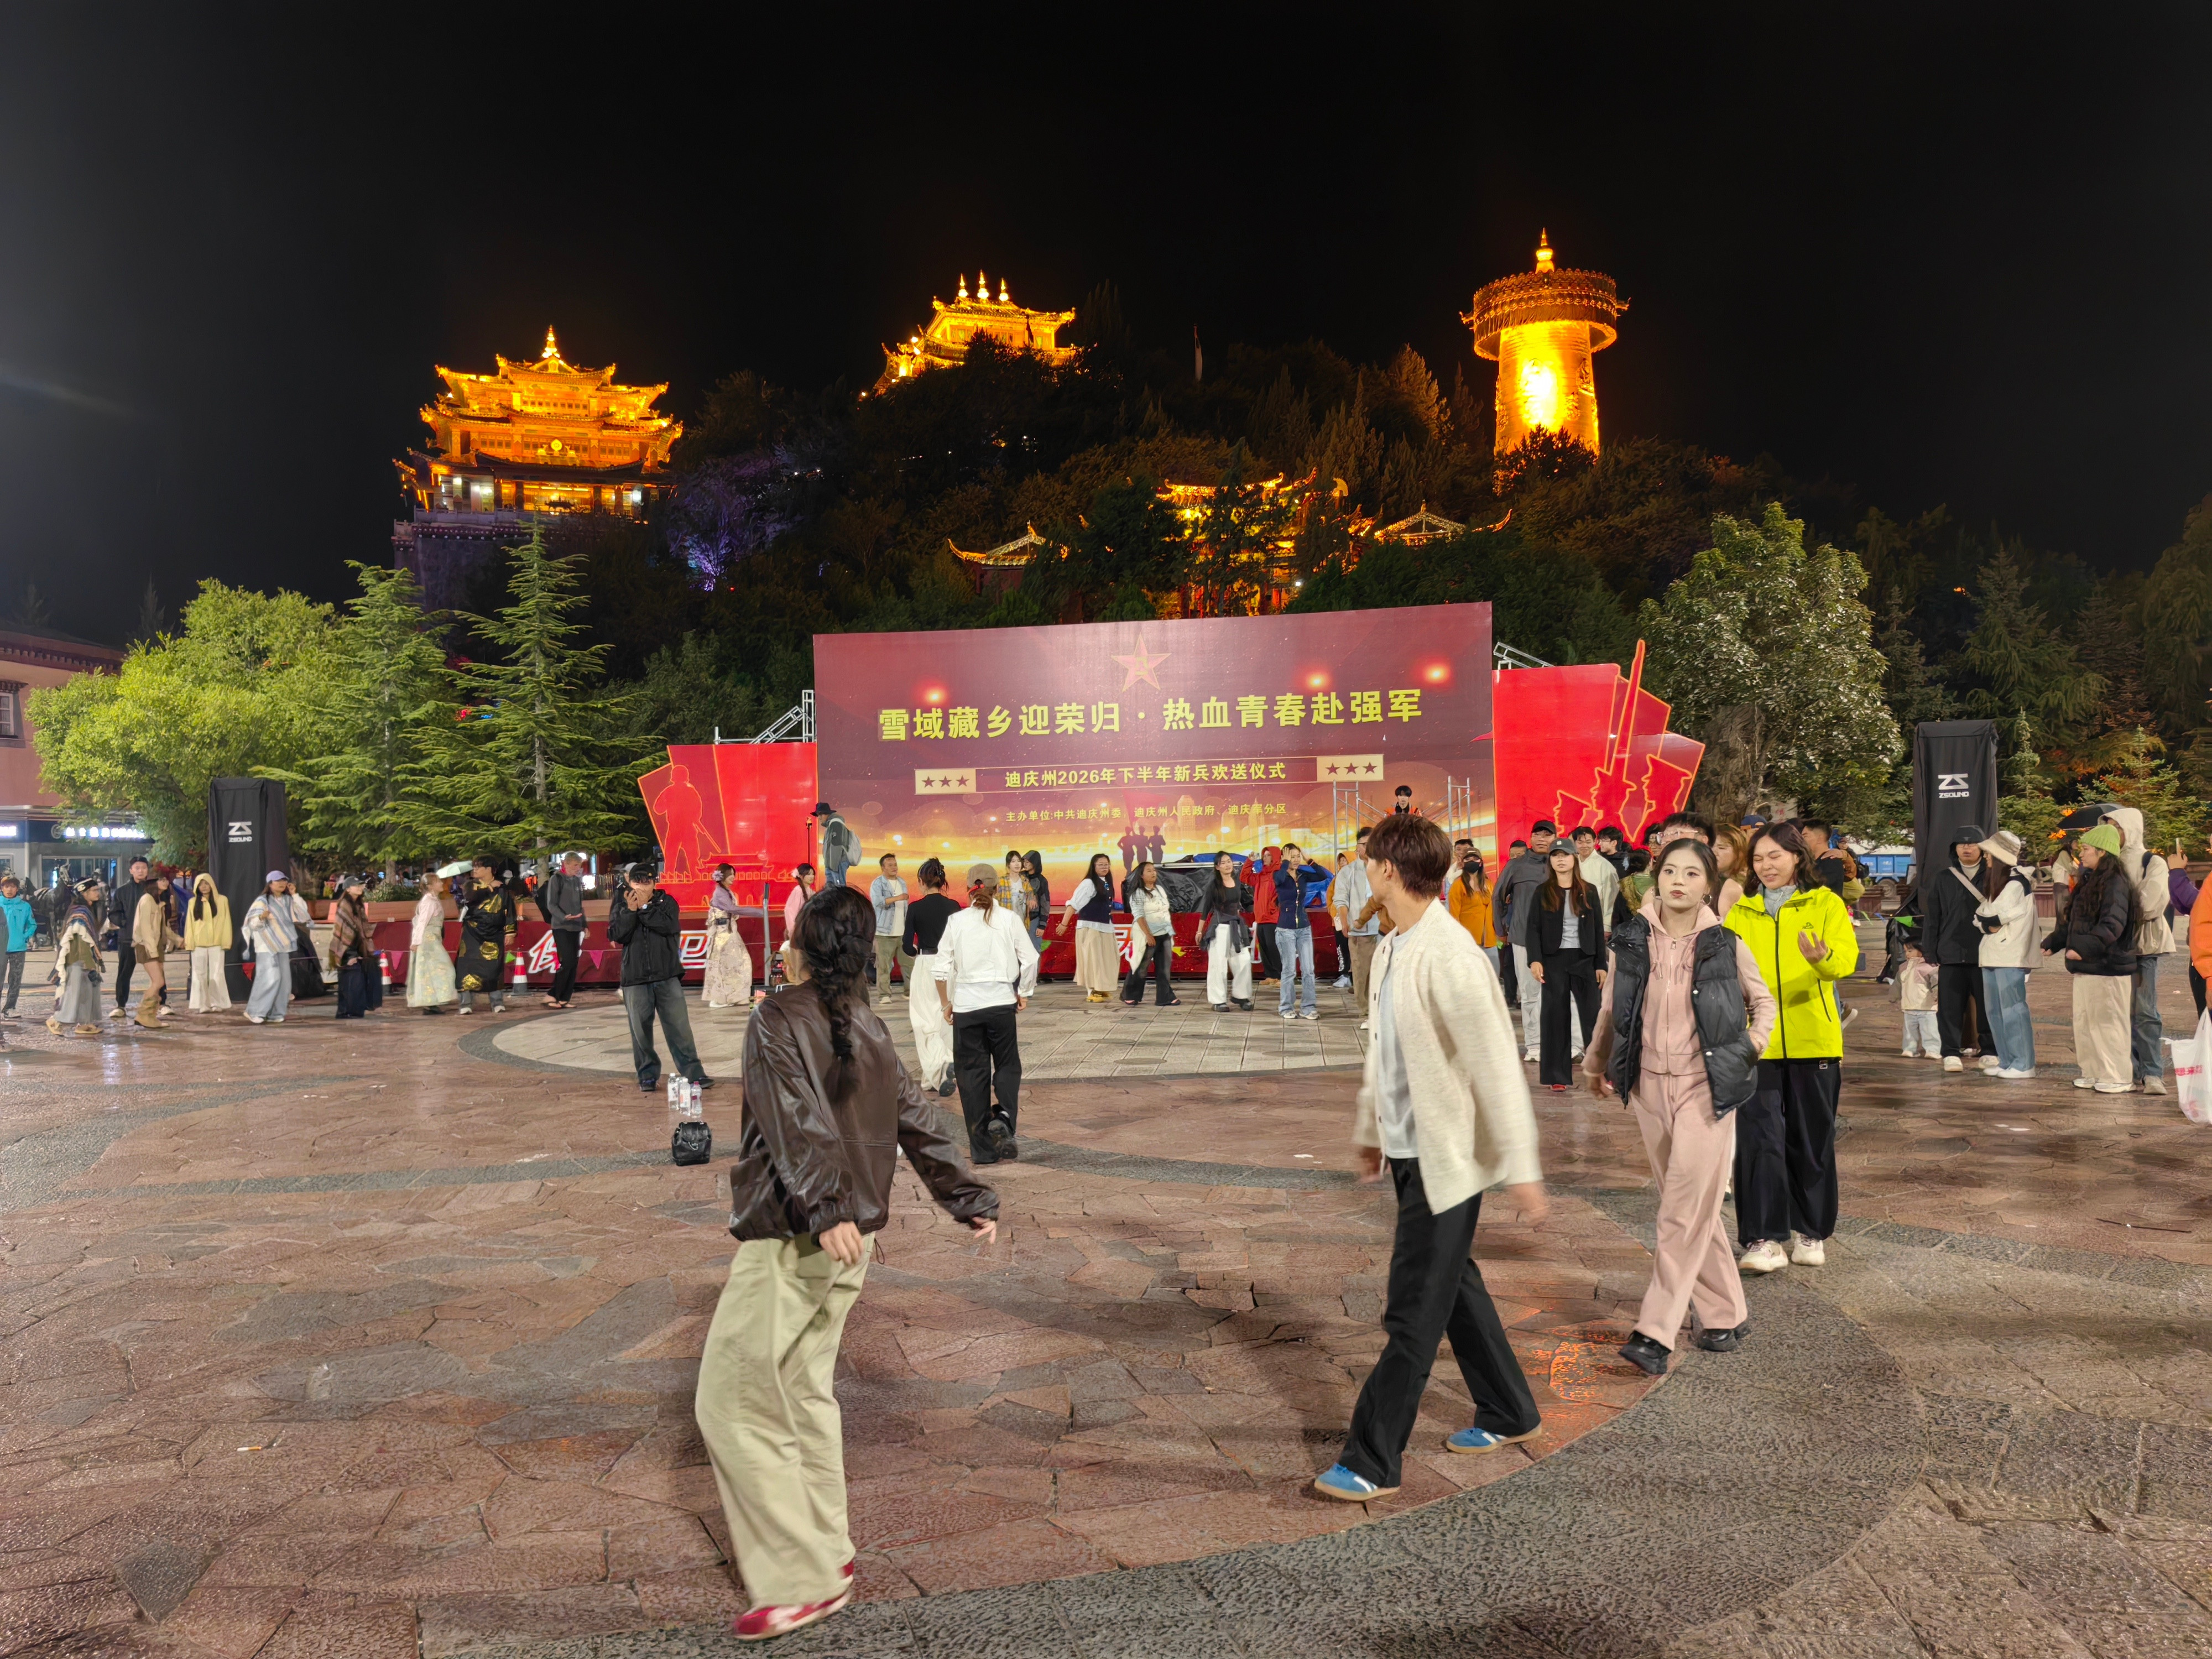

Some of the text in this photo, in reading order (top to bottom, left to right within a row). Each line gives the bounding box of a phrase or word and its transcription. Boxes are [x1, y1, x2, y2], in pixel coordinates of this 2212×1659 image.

[1005, 762, 1286, 787] 迪庆州2026年下半年新兵欢送仪式
